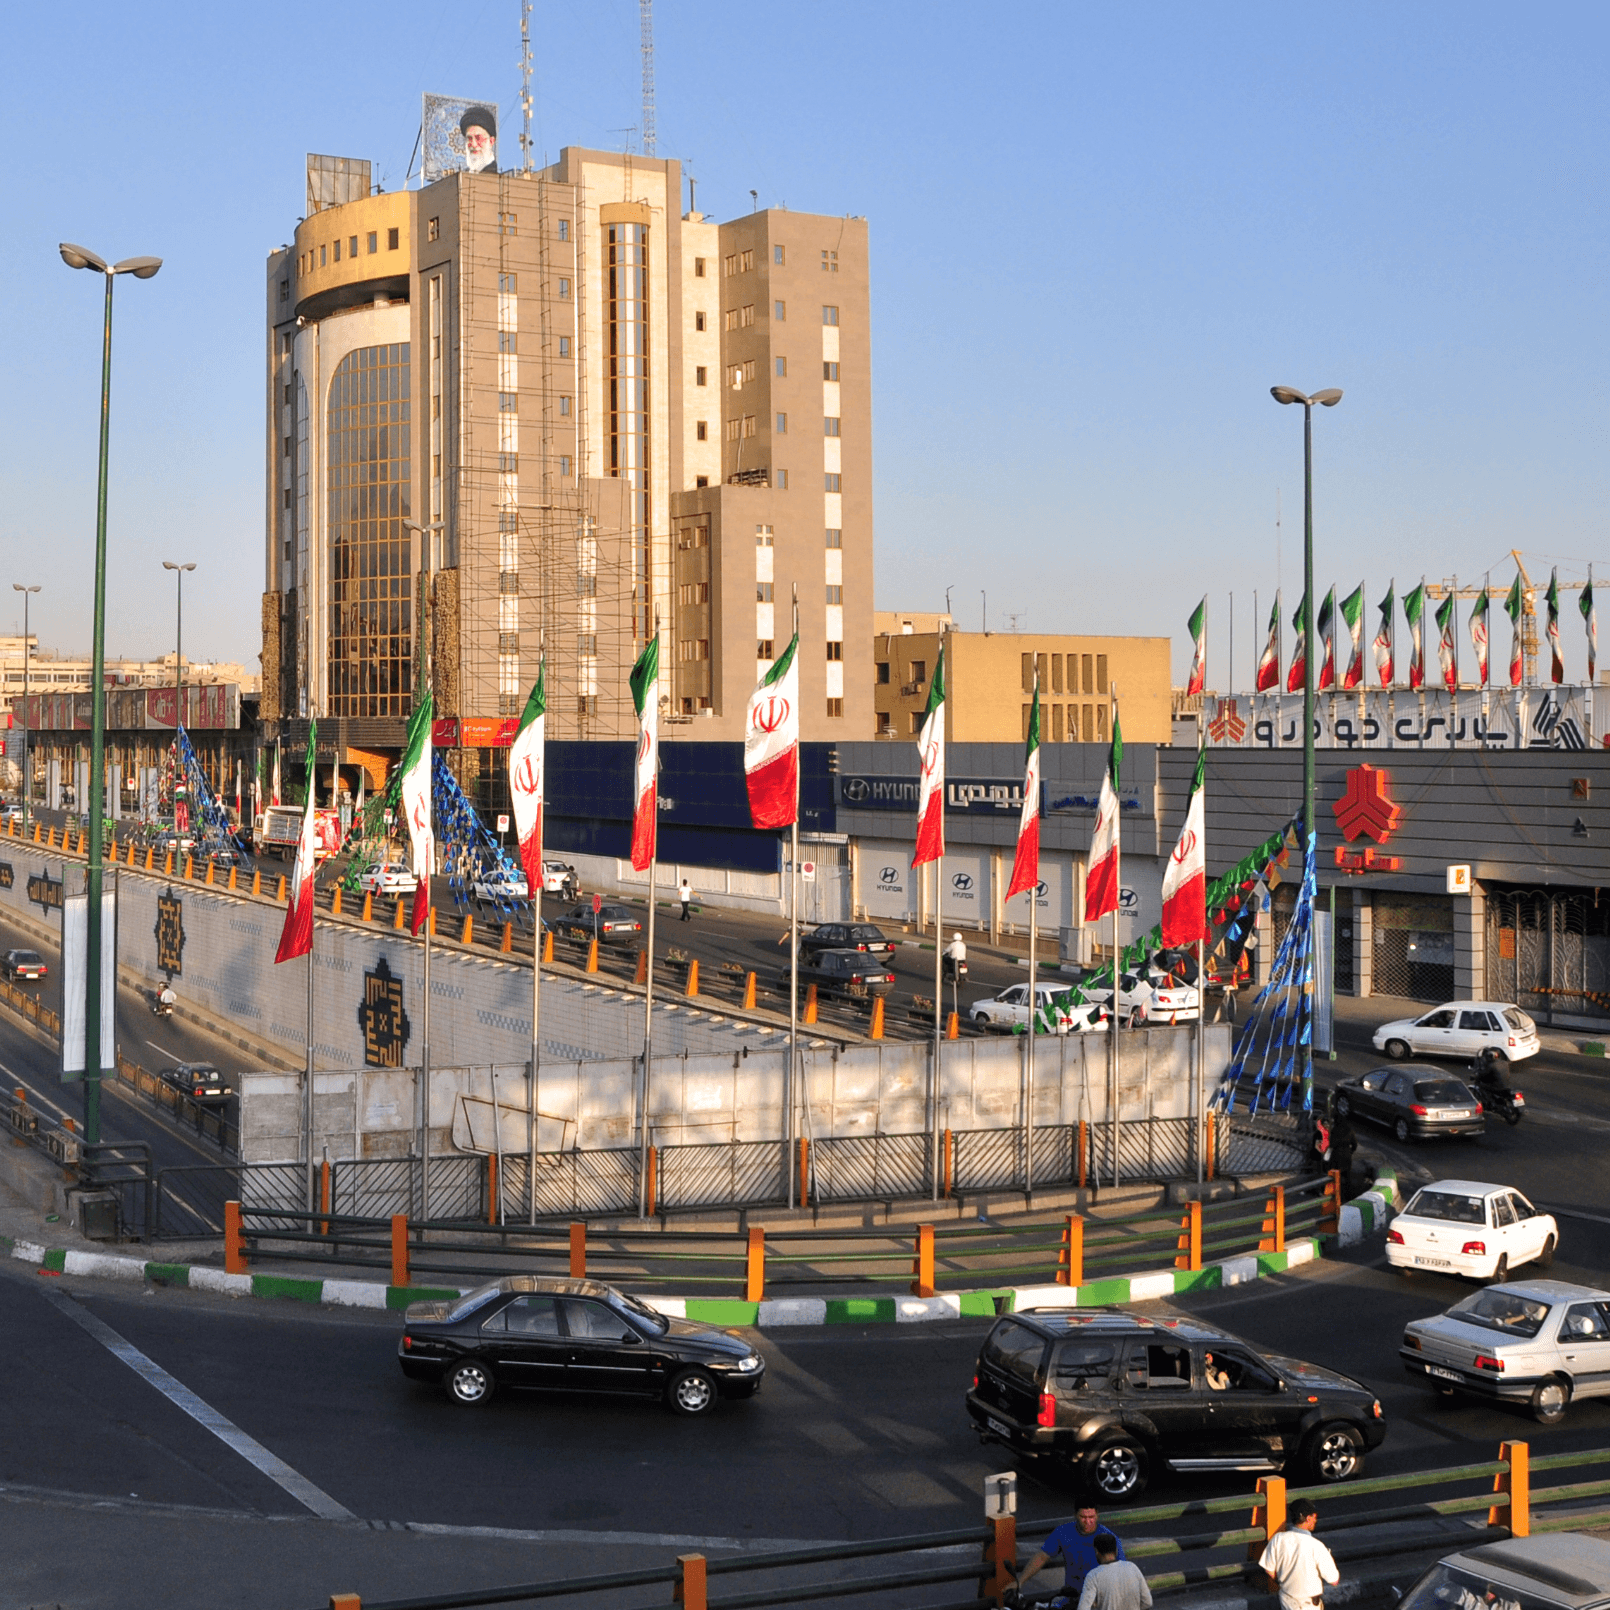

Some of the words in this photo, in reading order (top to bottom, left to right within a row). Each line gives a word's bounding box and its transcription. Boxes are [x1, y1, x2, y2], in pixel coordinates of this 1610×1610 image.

[872, 782, 921, 801] HYUND
[948, 783, 1025, 809] یوندای
[876, 884, 903, 892] HYUNDAI
[1119, 909, 1139, 918] UNDAI
